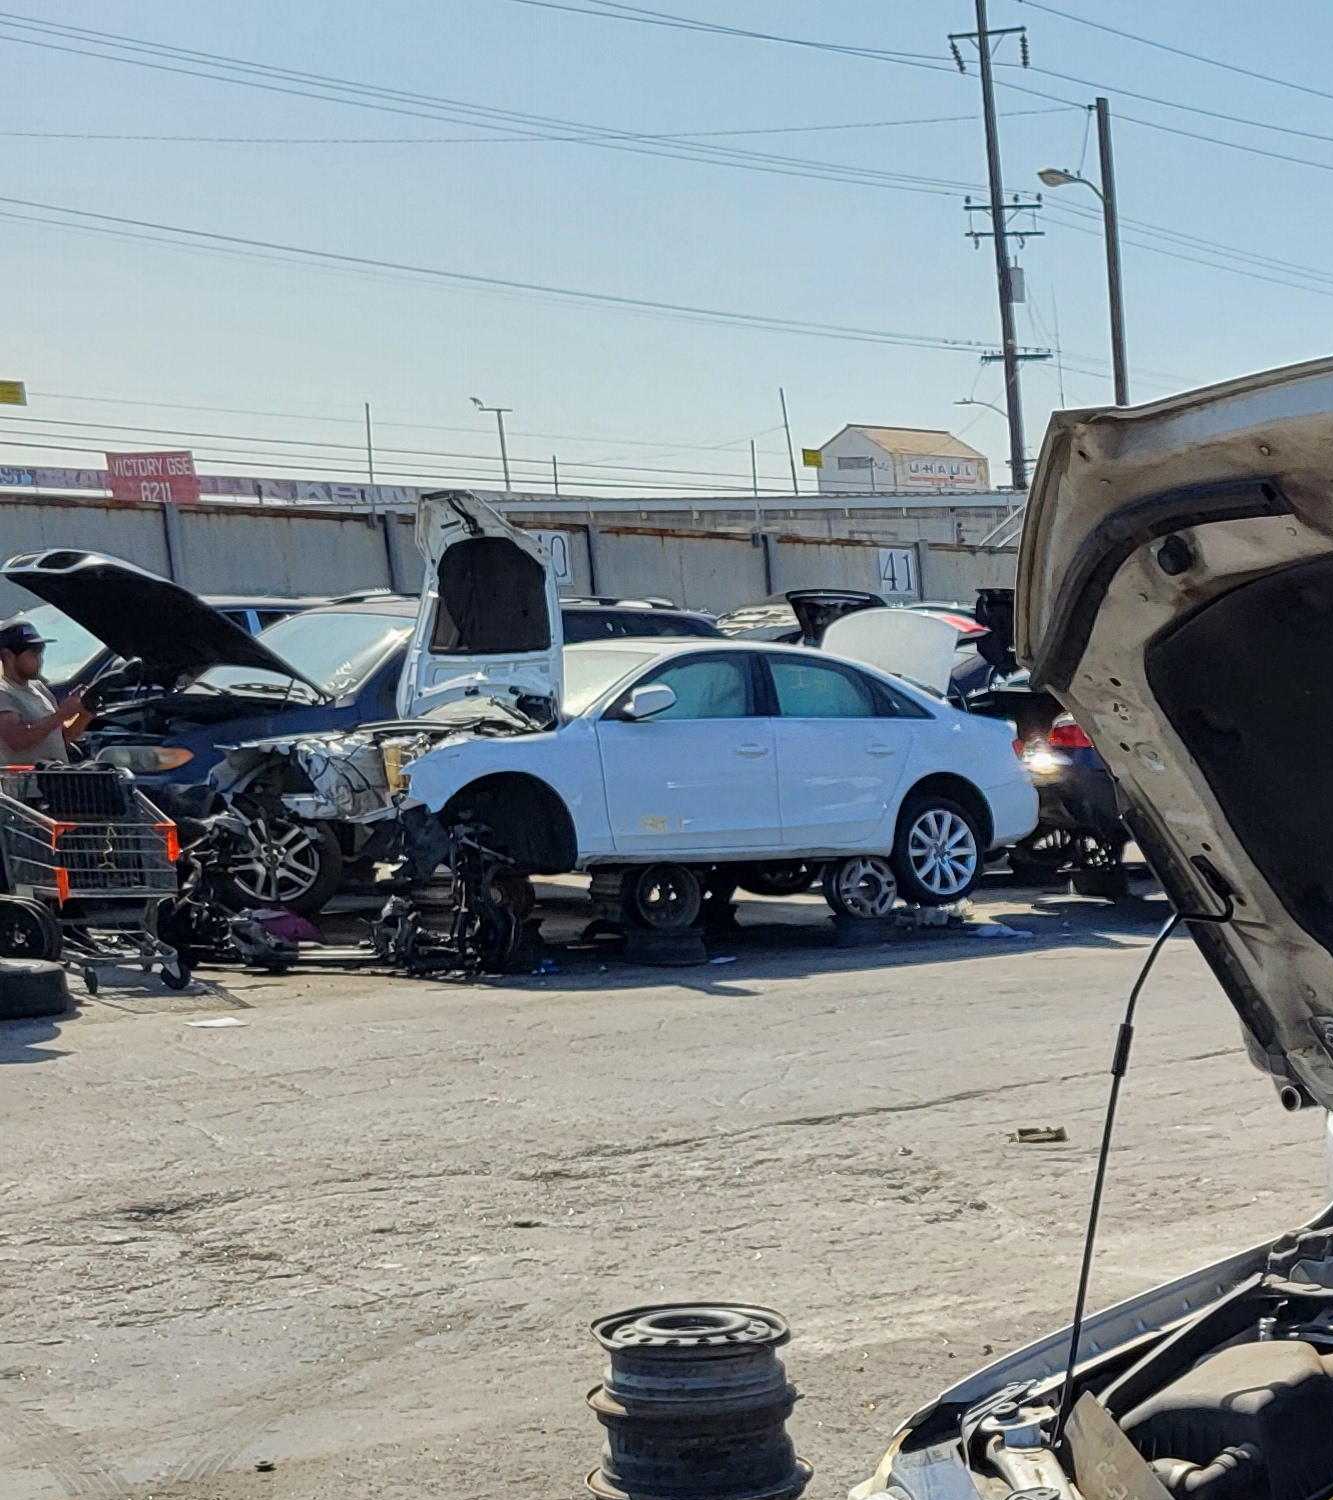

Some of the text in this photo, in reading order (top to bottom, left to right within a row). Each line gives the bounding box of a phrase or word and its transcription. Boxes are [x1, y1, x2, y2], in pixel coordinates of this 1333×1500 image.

[112, 457, 192, 476] VICTORY GSE
[882, 552, 913, 591] 41
